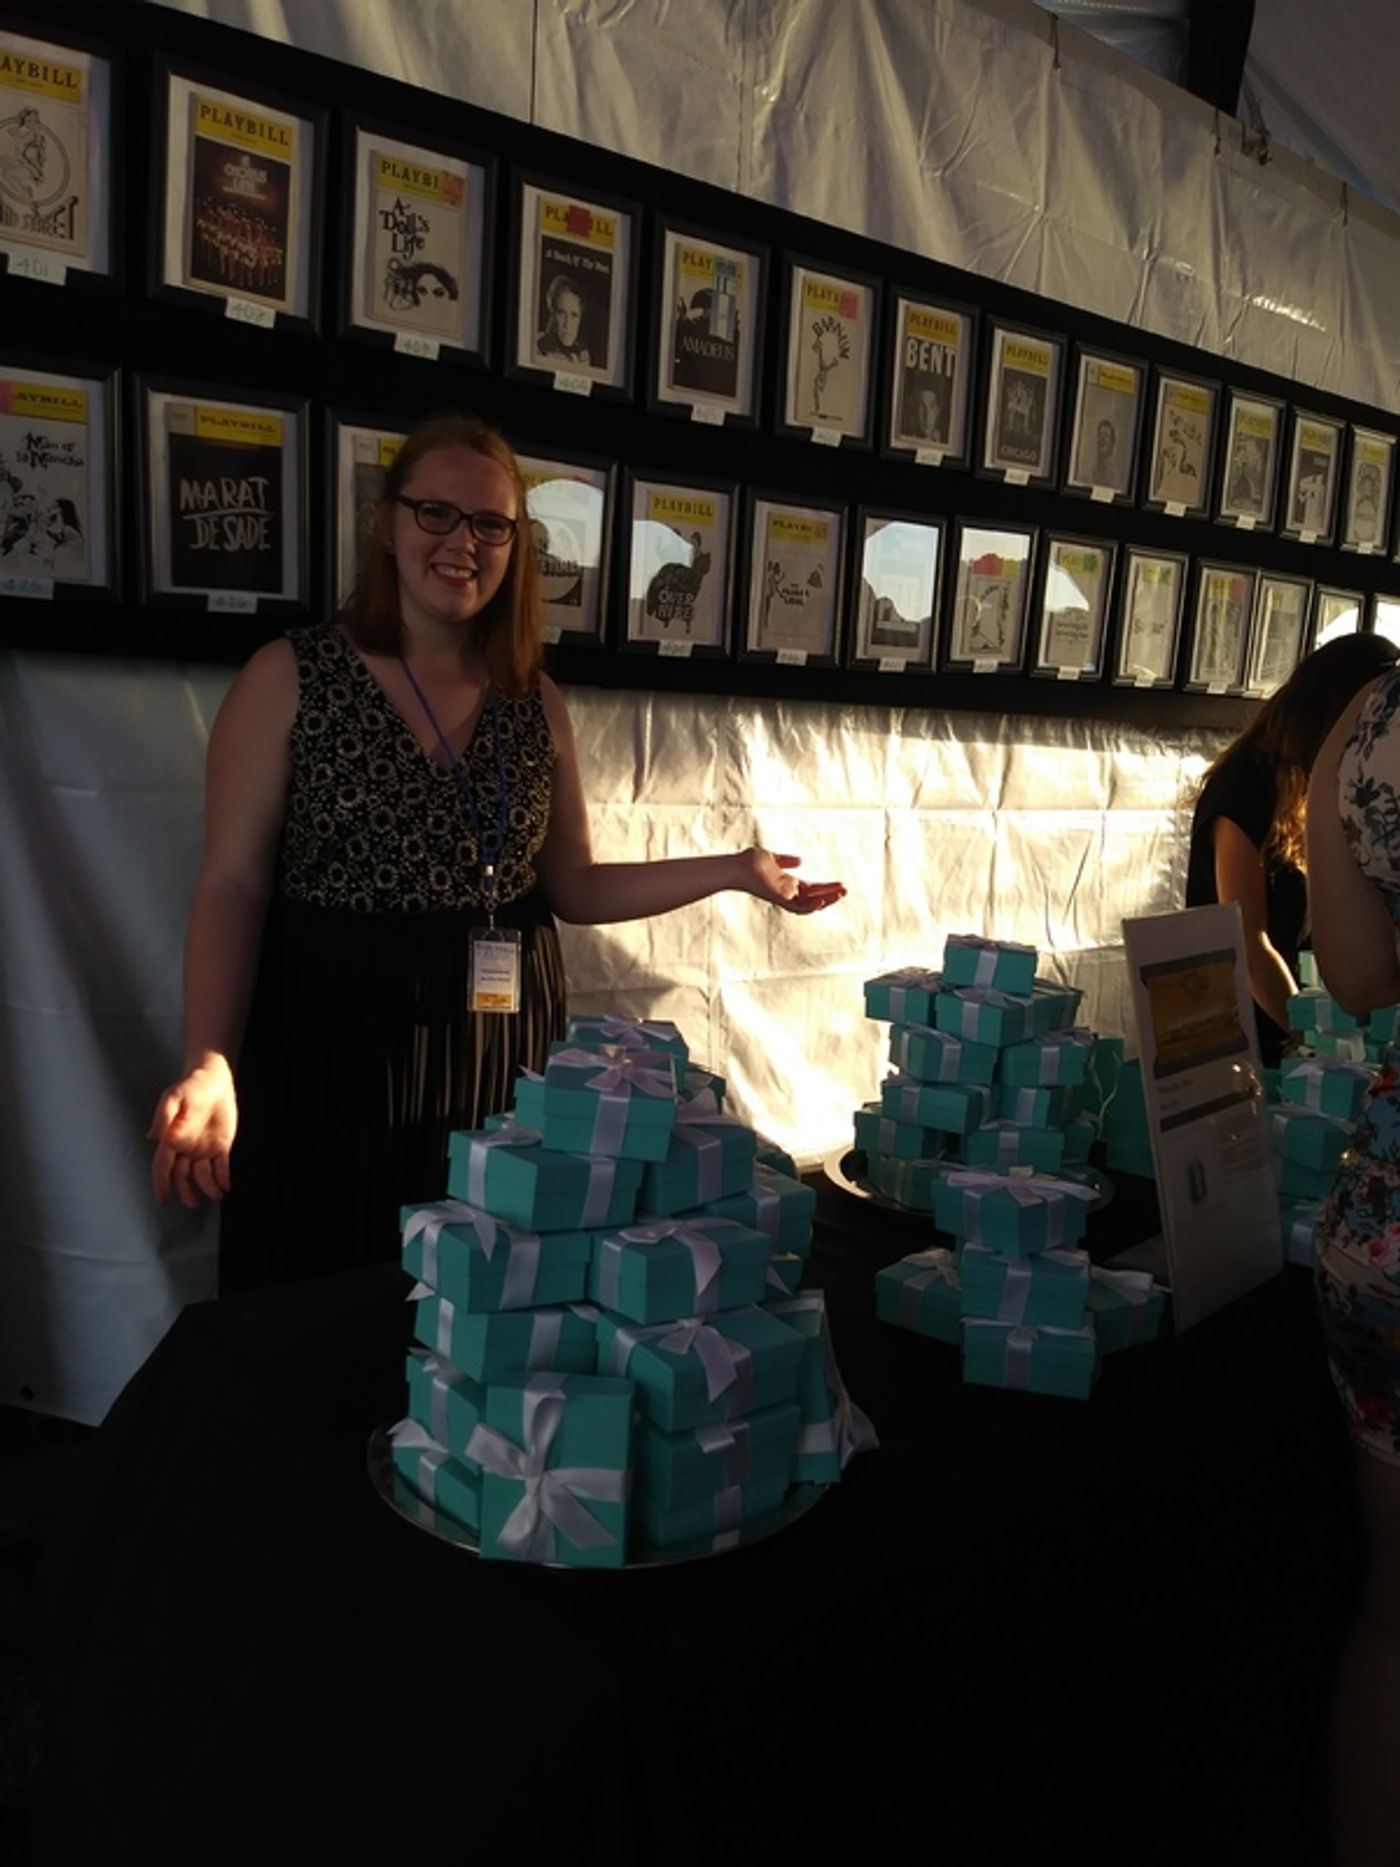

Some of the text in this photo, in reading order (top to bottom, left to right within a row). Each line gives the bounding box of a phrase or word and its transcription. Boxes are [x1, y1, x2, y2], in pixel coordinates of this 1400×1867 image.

[0, 56, 77, 90] AYBILL
[200, 104, 289, 146] PLAYBILL
[381, 160, 439, 189] PLAYBI
[545, 205, 613, 237] PLALL
[392, 233, 425, 260] Life
[910, 312, 957, 334] PLAYBILL
[906, 337, 957, 377] BENT
[18, 391, 84, 409] AYBILL
[201, 414, 277, 433] PLAYBILL
[179, 476, 269, 512] MARAT
[653, 496, 713, 518] PLAYBILL
[189, 515, 272, 551] DE SADE
